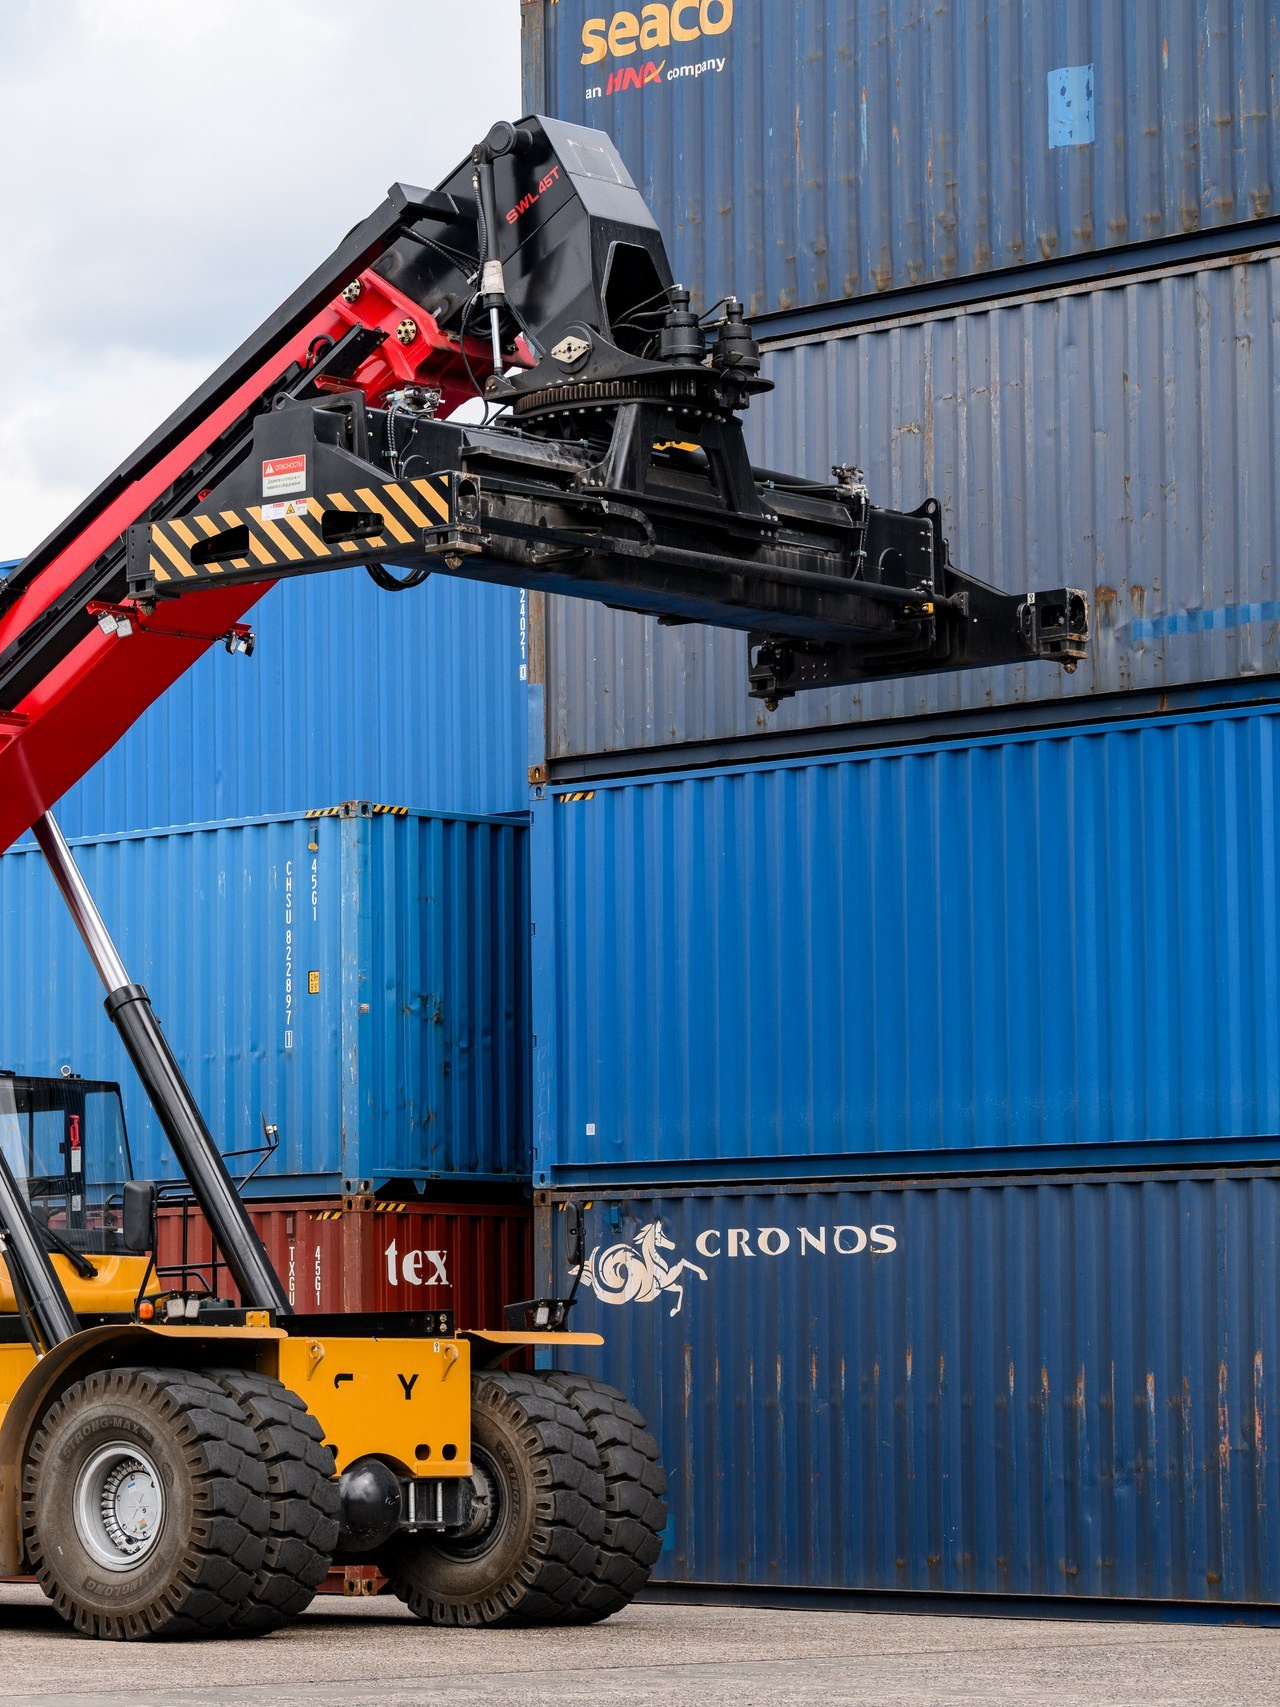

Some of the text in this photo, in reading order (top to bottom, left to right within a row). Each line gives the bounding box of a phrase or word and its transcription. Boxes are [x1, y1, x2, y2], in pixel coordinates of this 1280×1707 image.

[580, 0, 734, 65] seaco
[585, 57, 726, 100] an HNA company
[505, 165, 560, 225] SWL 45T
[285, 861, 293, 925] CHSU
[285, 929, 293, 1026] 822897
[695, 1224, 897, 1257] CRONOS
